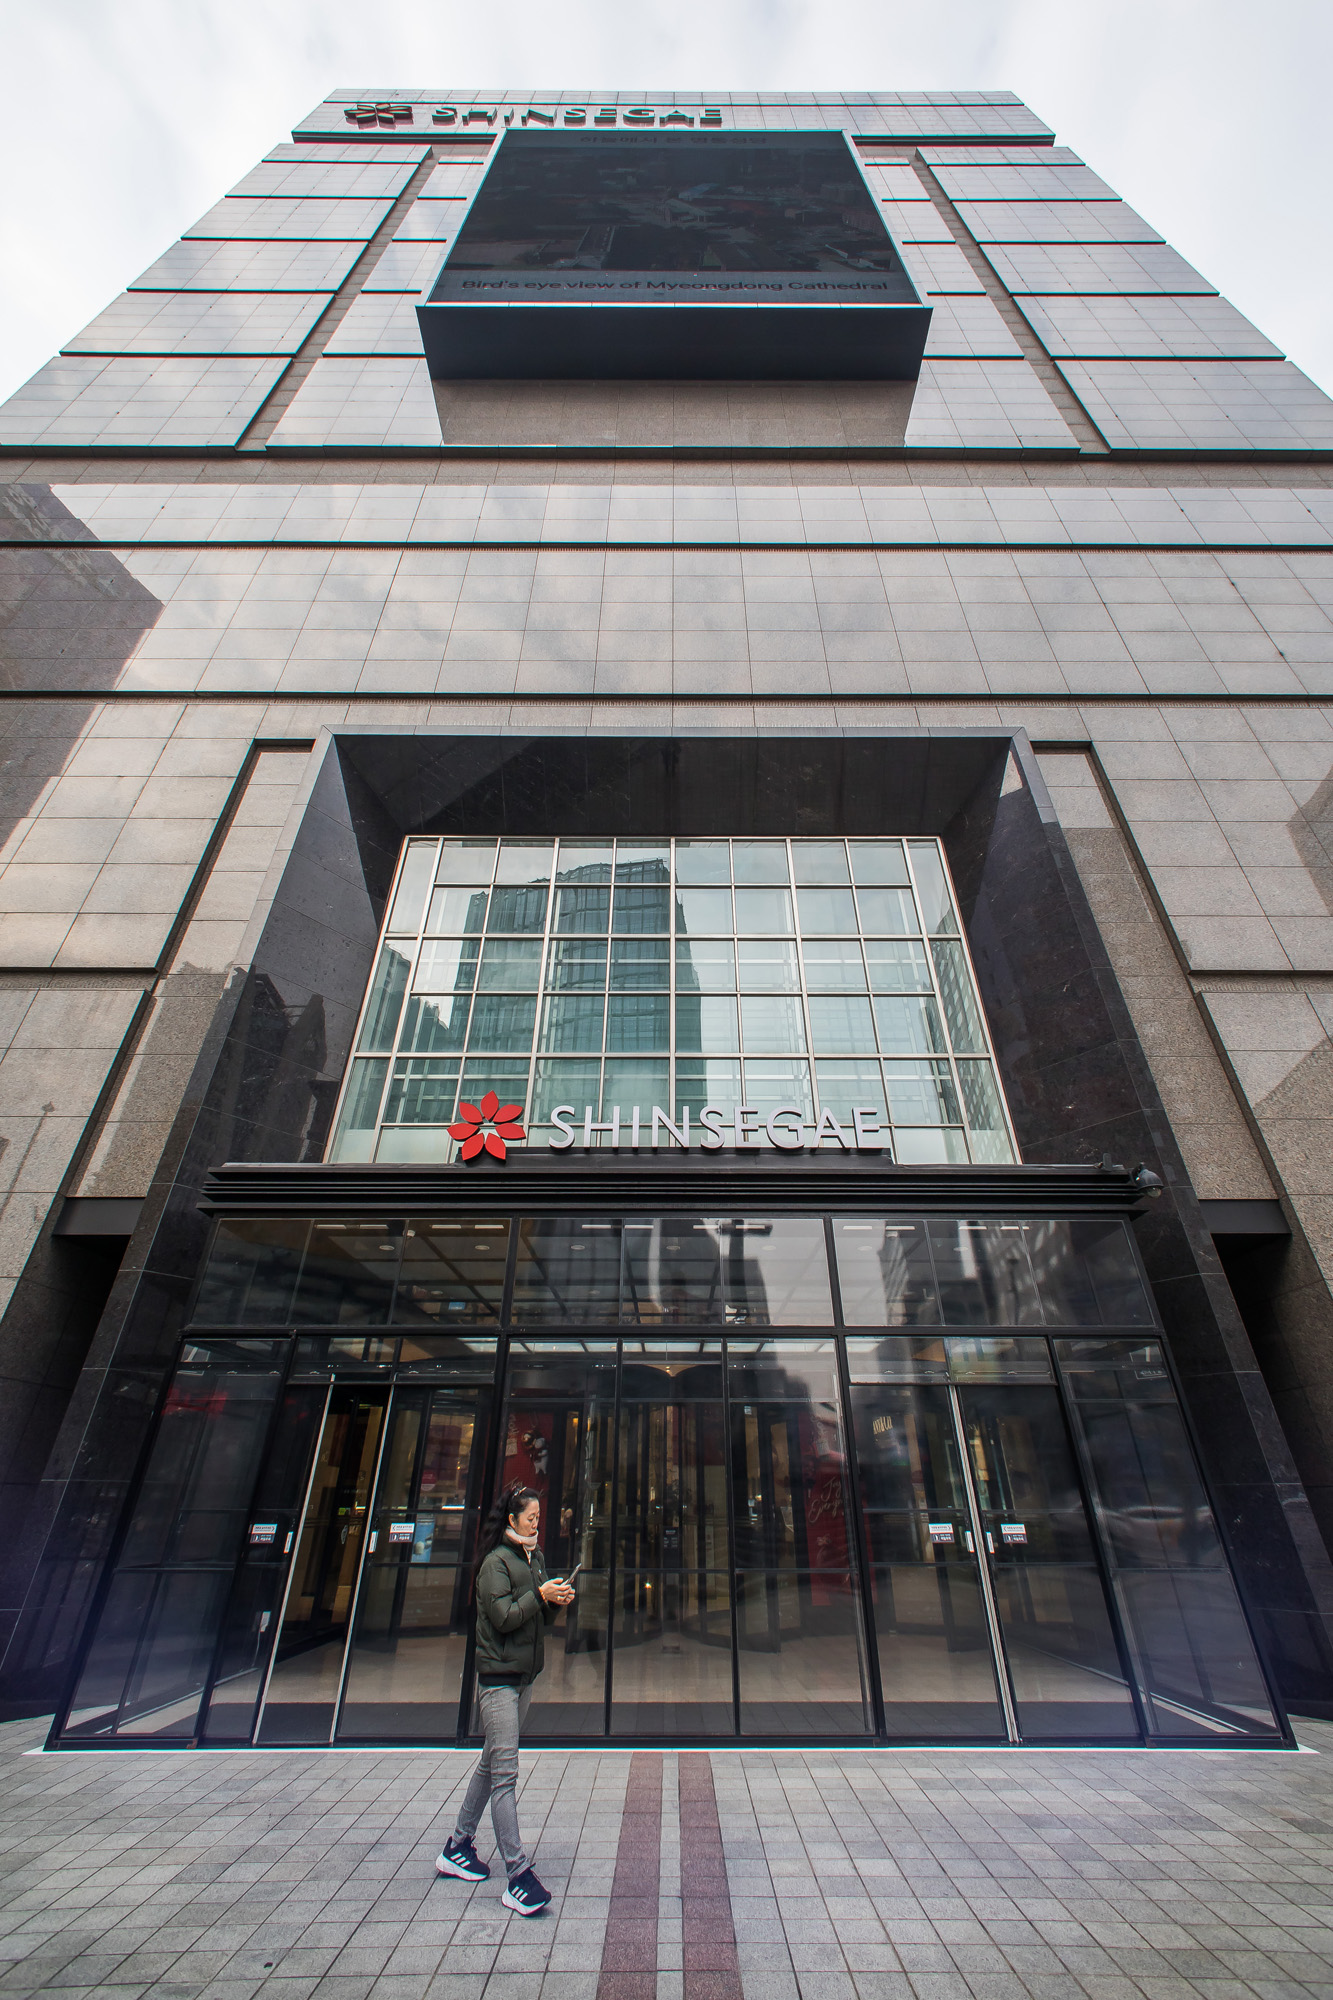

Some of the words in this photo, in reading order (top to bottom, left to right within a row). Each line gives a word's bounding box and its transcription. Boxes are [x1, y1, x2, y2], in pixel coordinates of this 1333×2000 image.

[432, 107, 722, 127] SHINSEGAE
[462, 280, 519, 289] Bird's
[524, 282, 562, 291] eye
[566, 280, 615, 289] view
[619, 280, 642, 289] of
[646, 280, 783, 292] Myeongdong
[788, 281, 889, 290] Cathedral
[548, 1105, 885, 1150] SHINSEGAE
